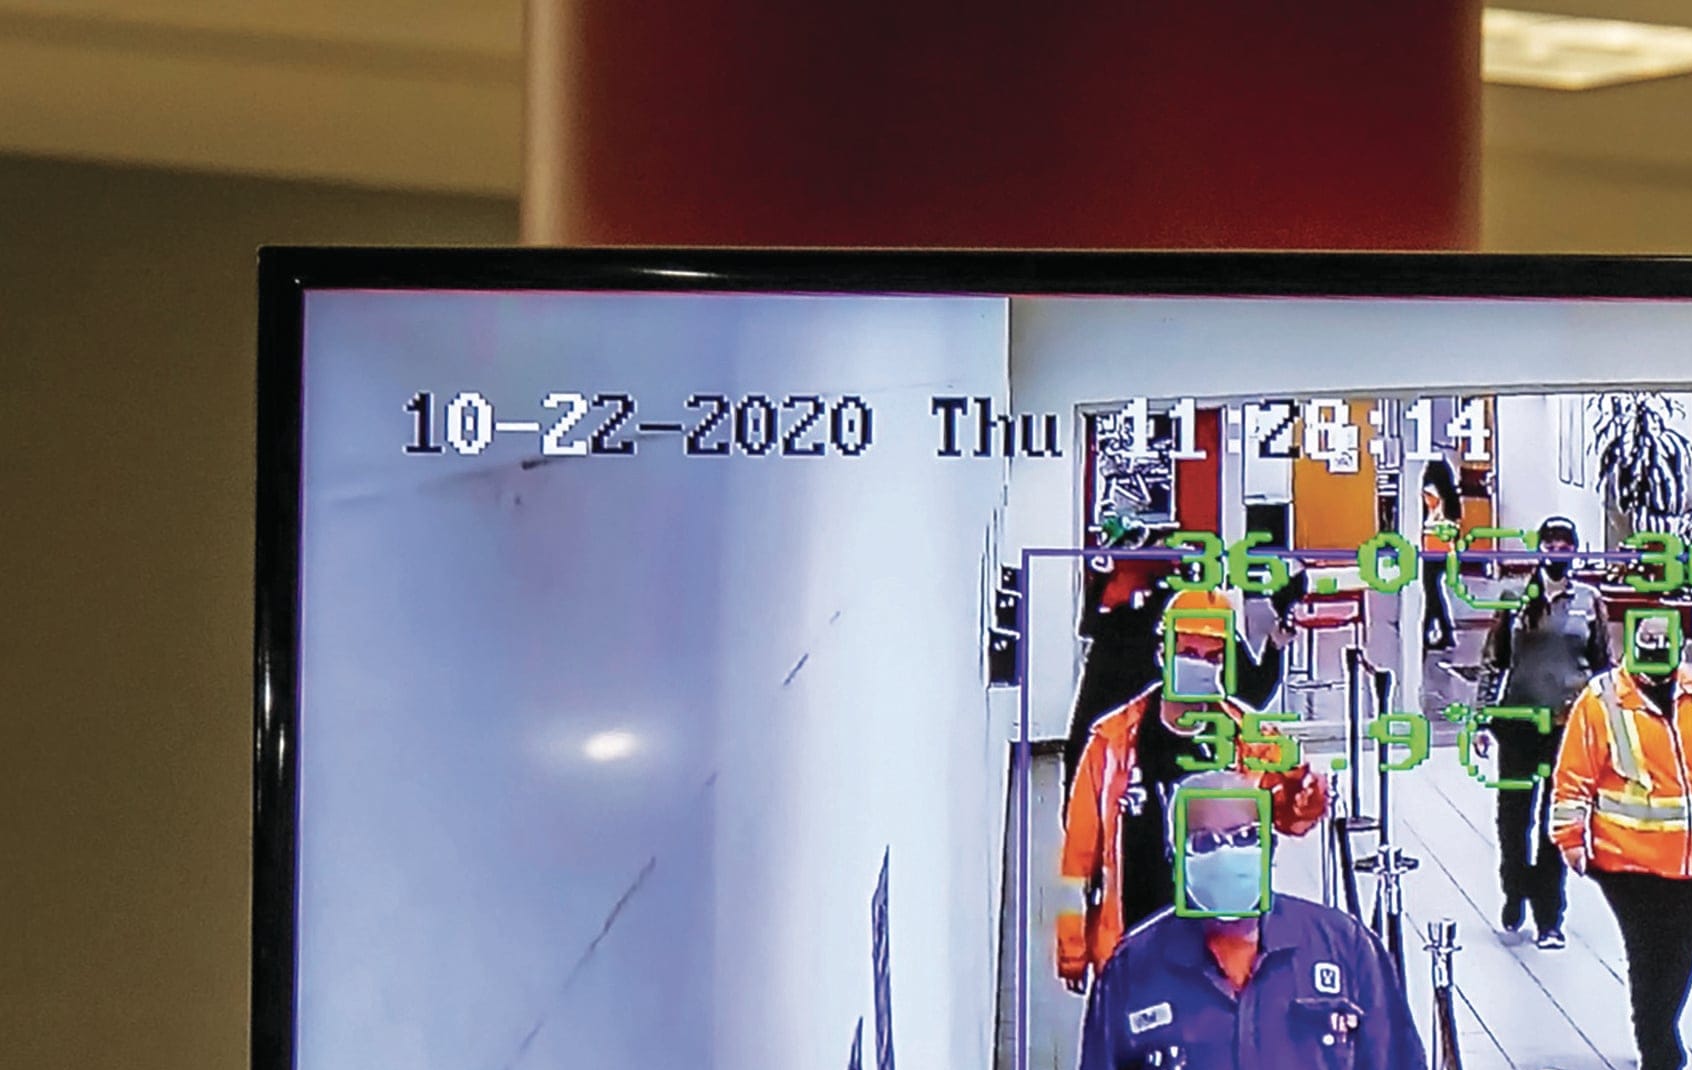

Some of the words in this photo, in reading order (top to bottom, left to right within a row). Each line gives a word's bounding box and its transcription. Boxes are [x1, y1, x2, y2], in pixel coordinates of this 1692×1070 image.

[402, 391, 875, 457] 10-22-2020
[931, 396, 1063, 458] Thu
[1117, 396, 1492, 462] 11:28:14
